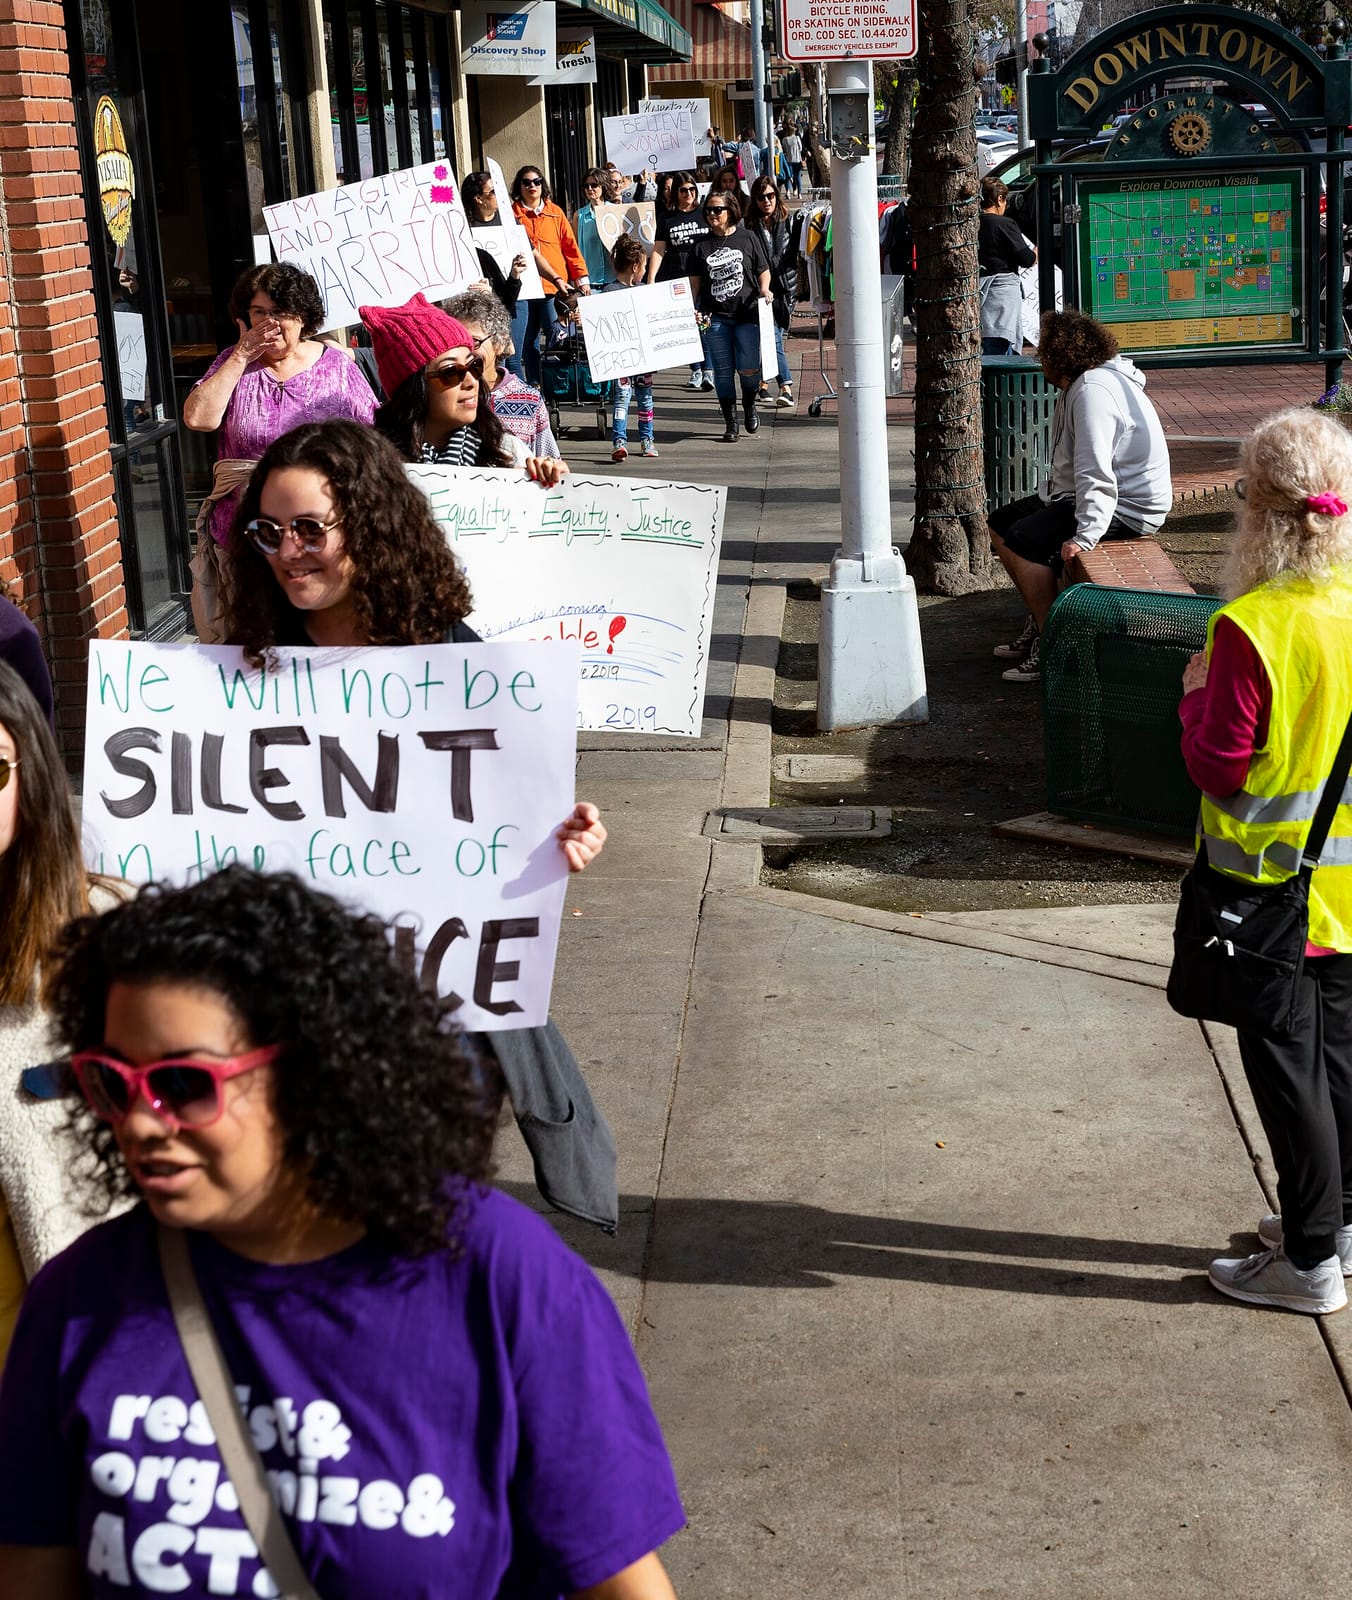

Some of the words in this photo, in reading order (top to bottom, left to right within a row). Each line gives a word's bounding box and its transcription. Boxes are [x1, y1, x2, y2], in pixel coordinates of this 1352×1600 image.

[788, 19, 801, 29] OR
[804, 18, 844, 28] SKATING
[847, 17, 860, 27] ON
[863, 16, 910, 27] SIDEWALK
[811, 5, 850, 16] BICYCLE
[791, 31, 813, 41] ORD.
[816, 30, 835, 40] COD
[838, 30, 859, 39] SEC.
[861, 28, 908, 38] 10.44.020
[470, 46, 519, 57] Discovery
[521, 46, 546, 57] Shop
[561, 55, 595, 69] fresh.
[1063, 23, 1313, 115] DOWNTOWN
[619, 111, 688, 135] BELIEVE
[1114, 97, 1270, 158] NFORMATON
[620, 131, 681, 153] WOMEN
[98, 159, 128, 183] VISALIA
[1119, 181, 1161, 193] Explore
[1163, 178, 1221, 191] Downtown
[1224, 175, 1259, 187] Visalia
[263, 197, 319, 232] I'M
[334, 187, 357, 211] A
[359, 169, 431, 204] GIRL
[278, 220, 333, 260] AND
[334, 200, 394, 242] I'M
[410, 189, 433, 219] A
[720, 268, 734, 277] SHE
[713, 280, 742, 293] PERSISTED
[430, 489, 512, 544] Equality
[540, 496, 609, 547] Equity
[626, 498, 693, 538] Justice
[97, 649, 175, 714] We
[217, 656, 318, 716] will
[341, 660, 446, 719] not
[463, 657, 544, 713] be
[591, 664, 620, 680] 2019
[605, 703, 657, 728] 2019
[100, 725, 502, 823] SILENT
[304, 828, 422, 880] face
[456, 823, 521, 877] of
